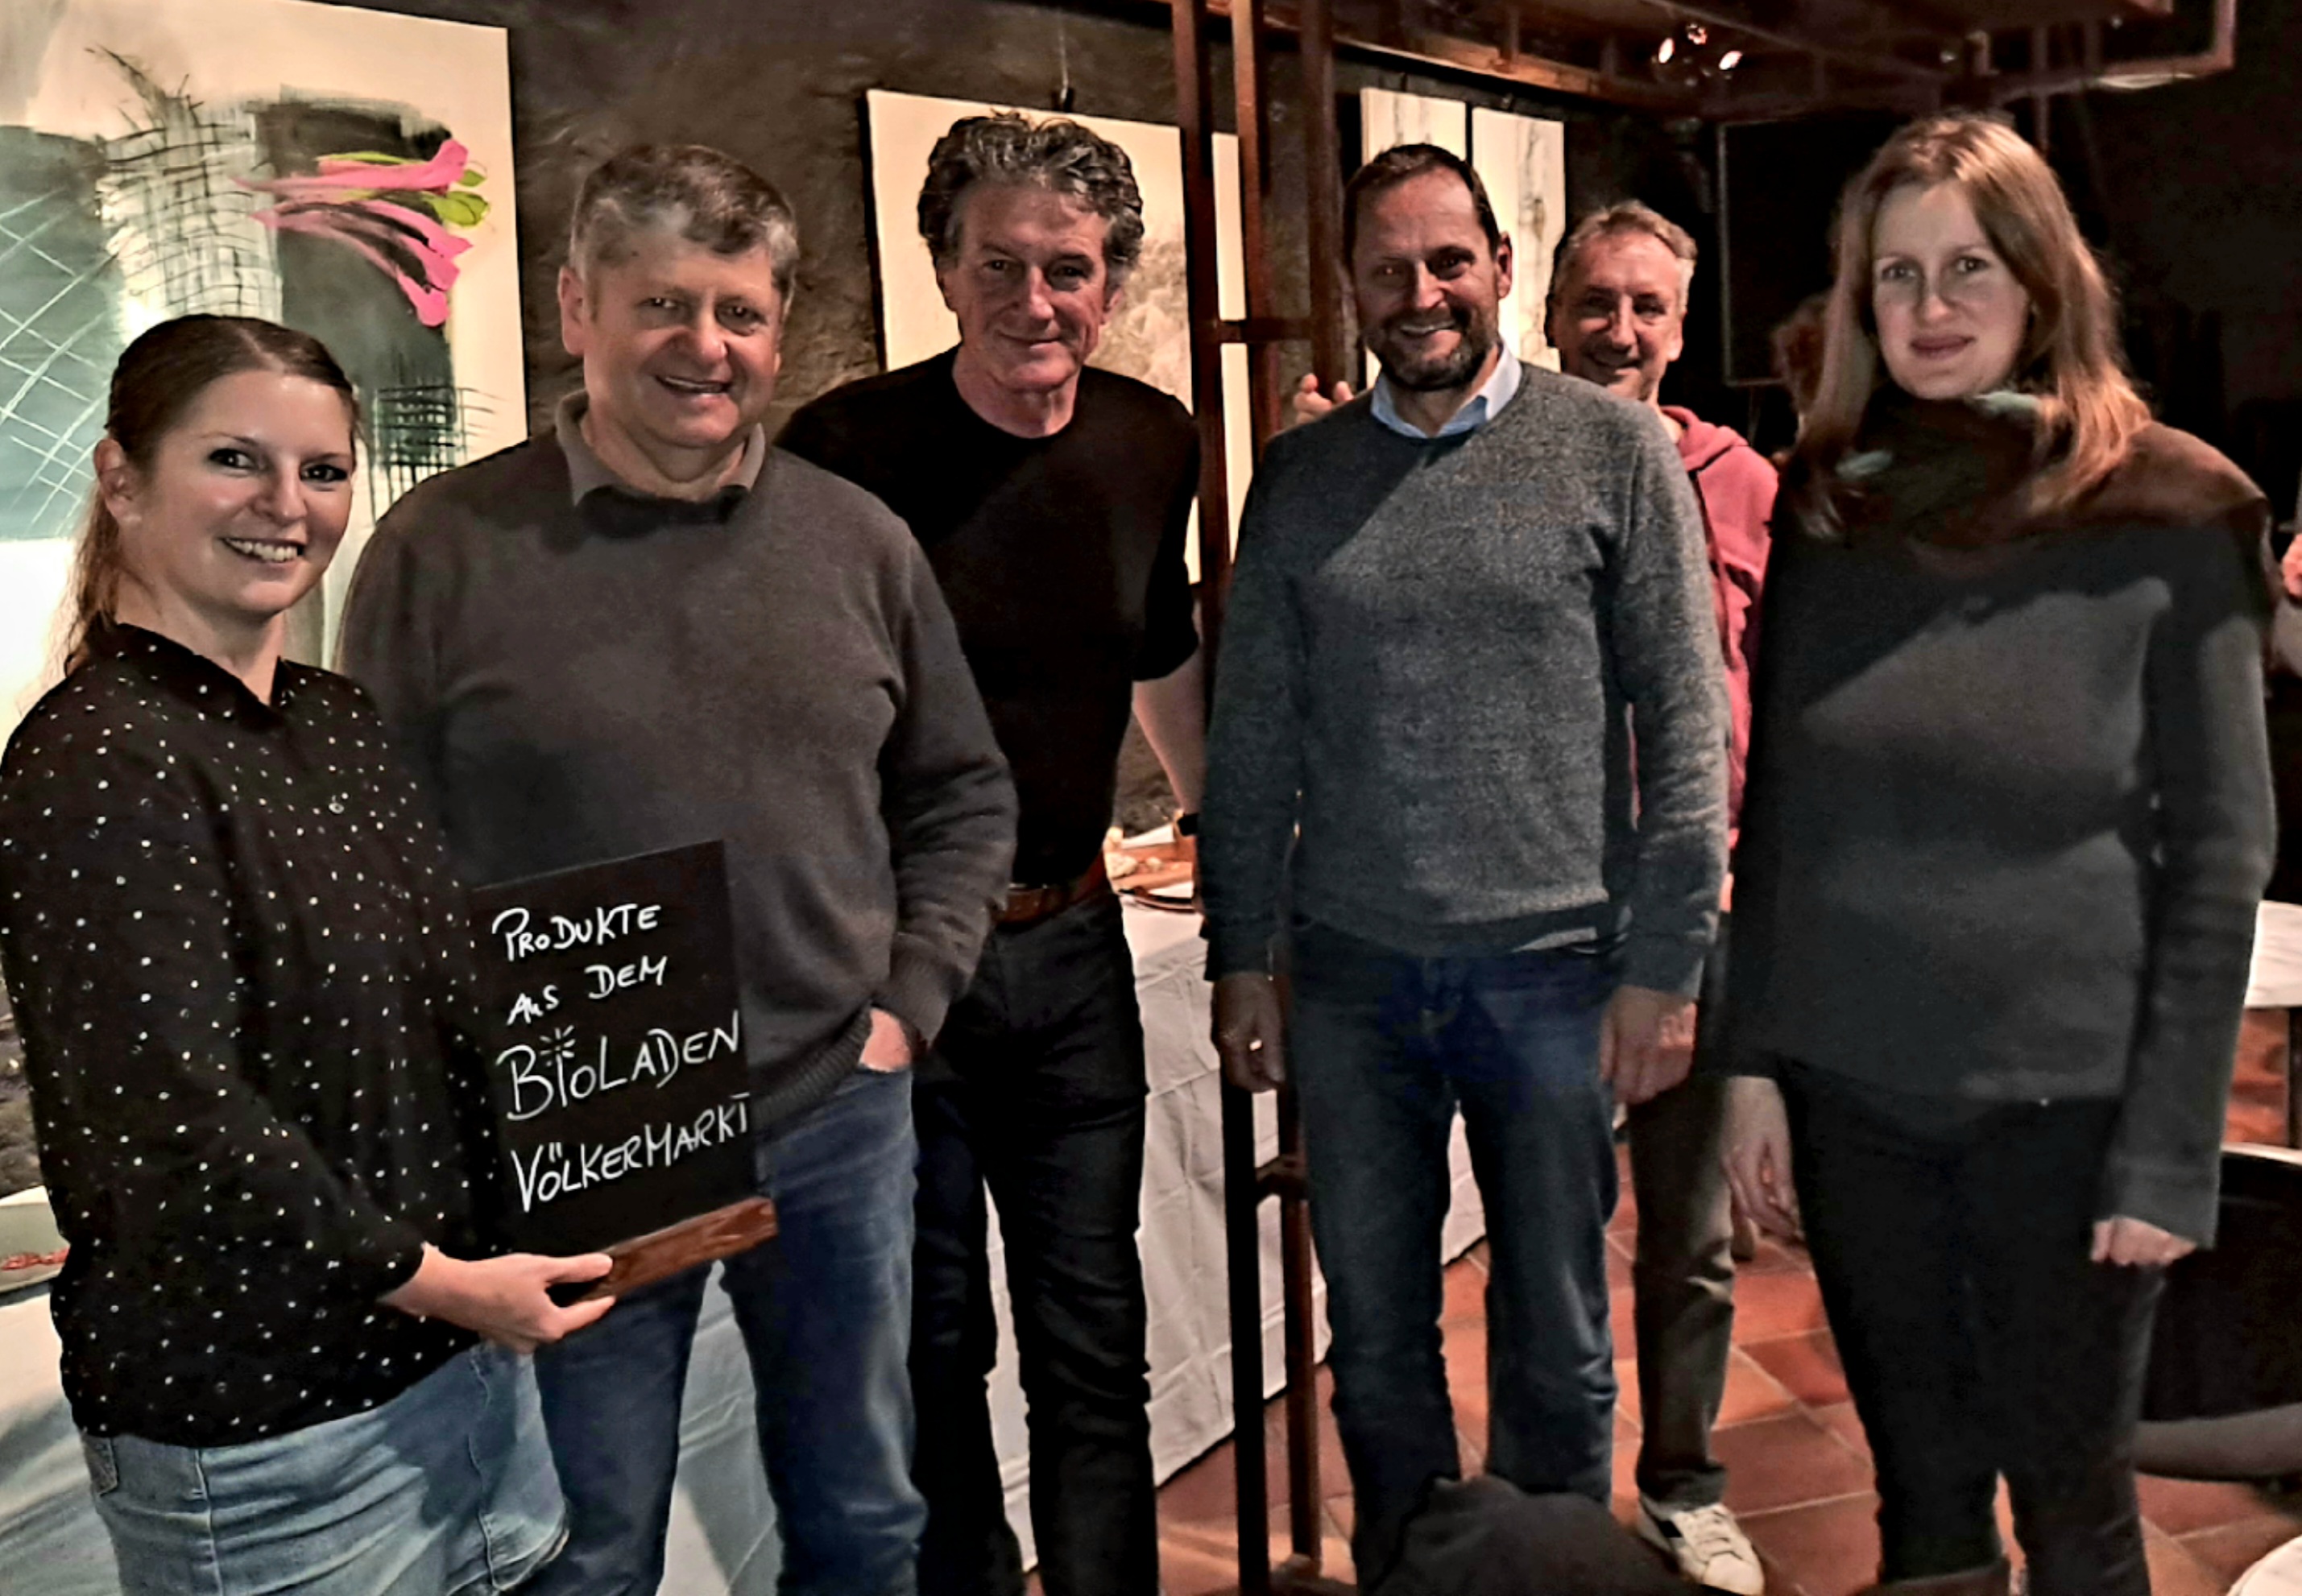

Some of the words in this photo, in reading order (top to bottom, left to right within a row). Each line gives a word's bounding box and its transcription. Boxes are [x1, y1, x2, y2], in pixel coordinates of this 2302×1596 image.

[491, 904, 661, 961] PRODUKTE
[585, 955, 668, 999] DEM
[511, 1093, 750, 1213] VÖLKERMARKT
